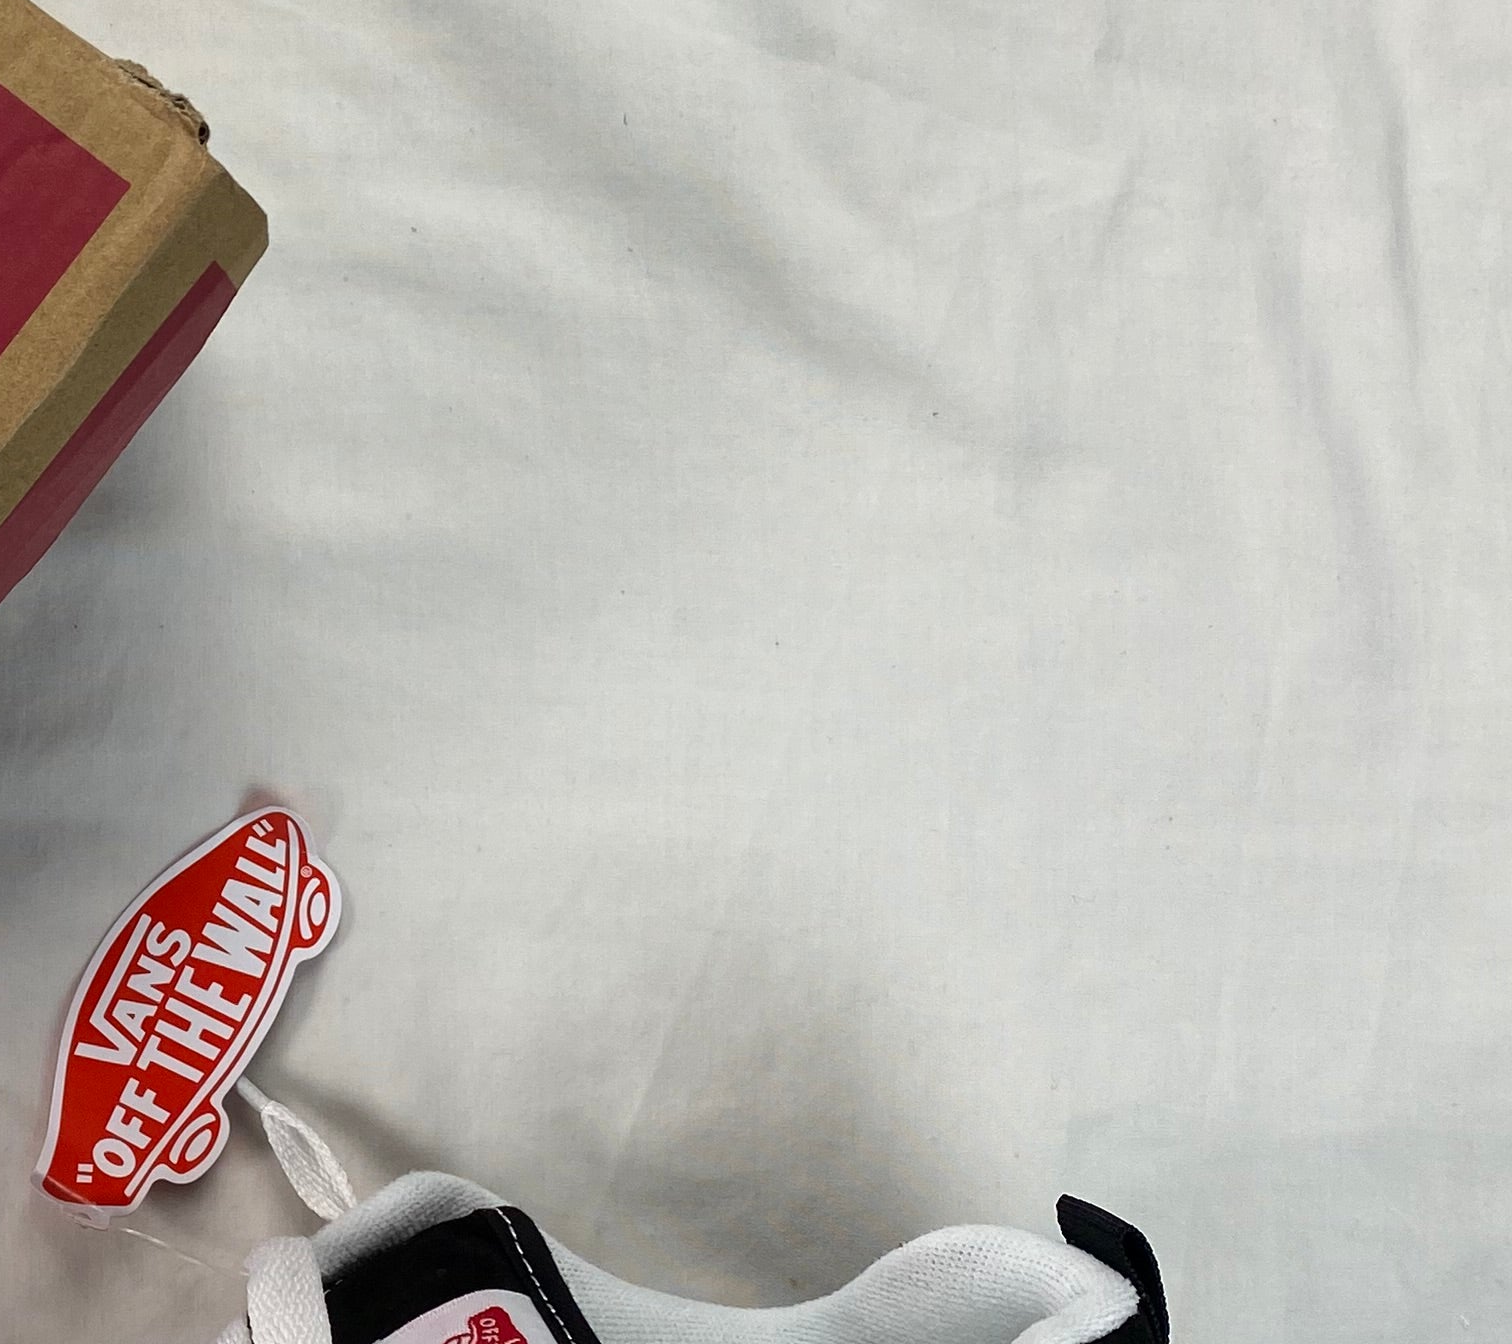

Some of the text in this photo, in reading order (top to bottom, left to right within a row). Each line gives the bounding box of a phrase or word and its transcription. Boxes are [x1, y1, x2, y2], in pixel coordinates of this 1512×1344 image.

[74, 913, 192, 1066] VANS
[76, 818, 288, 1184] "OFF THE WALL"
